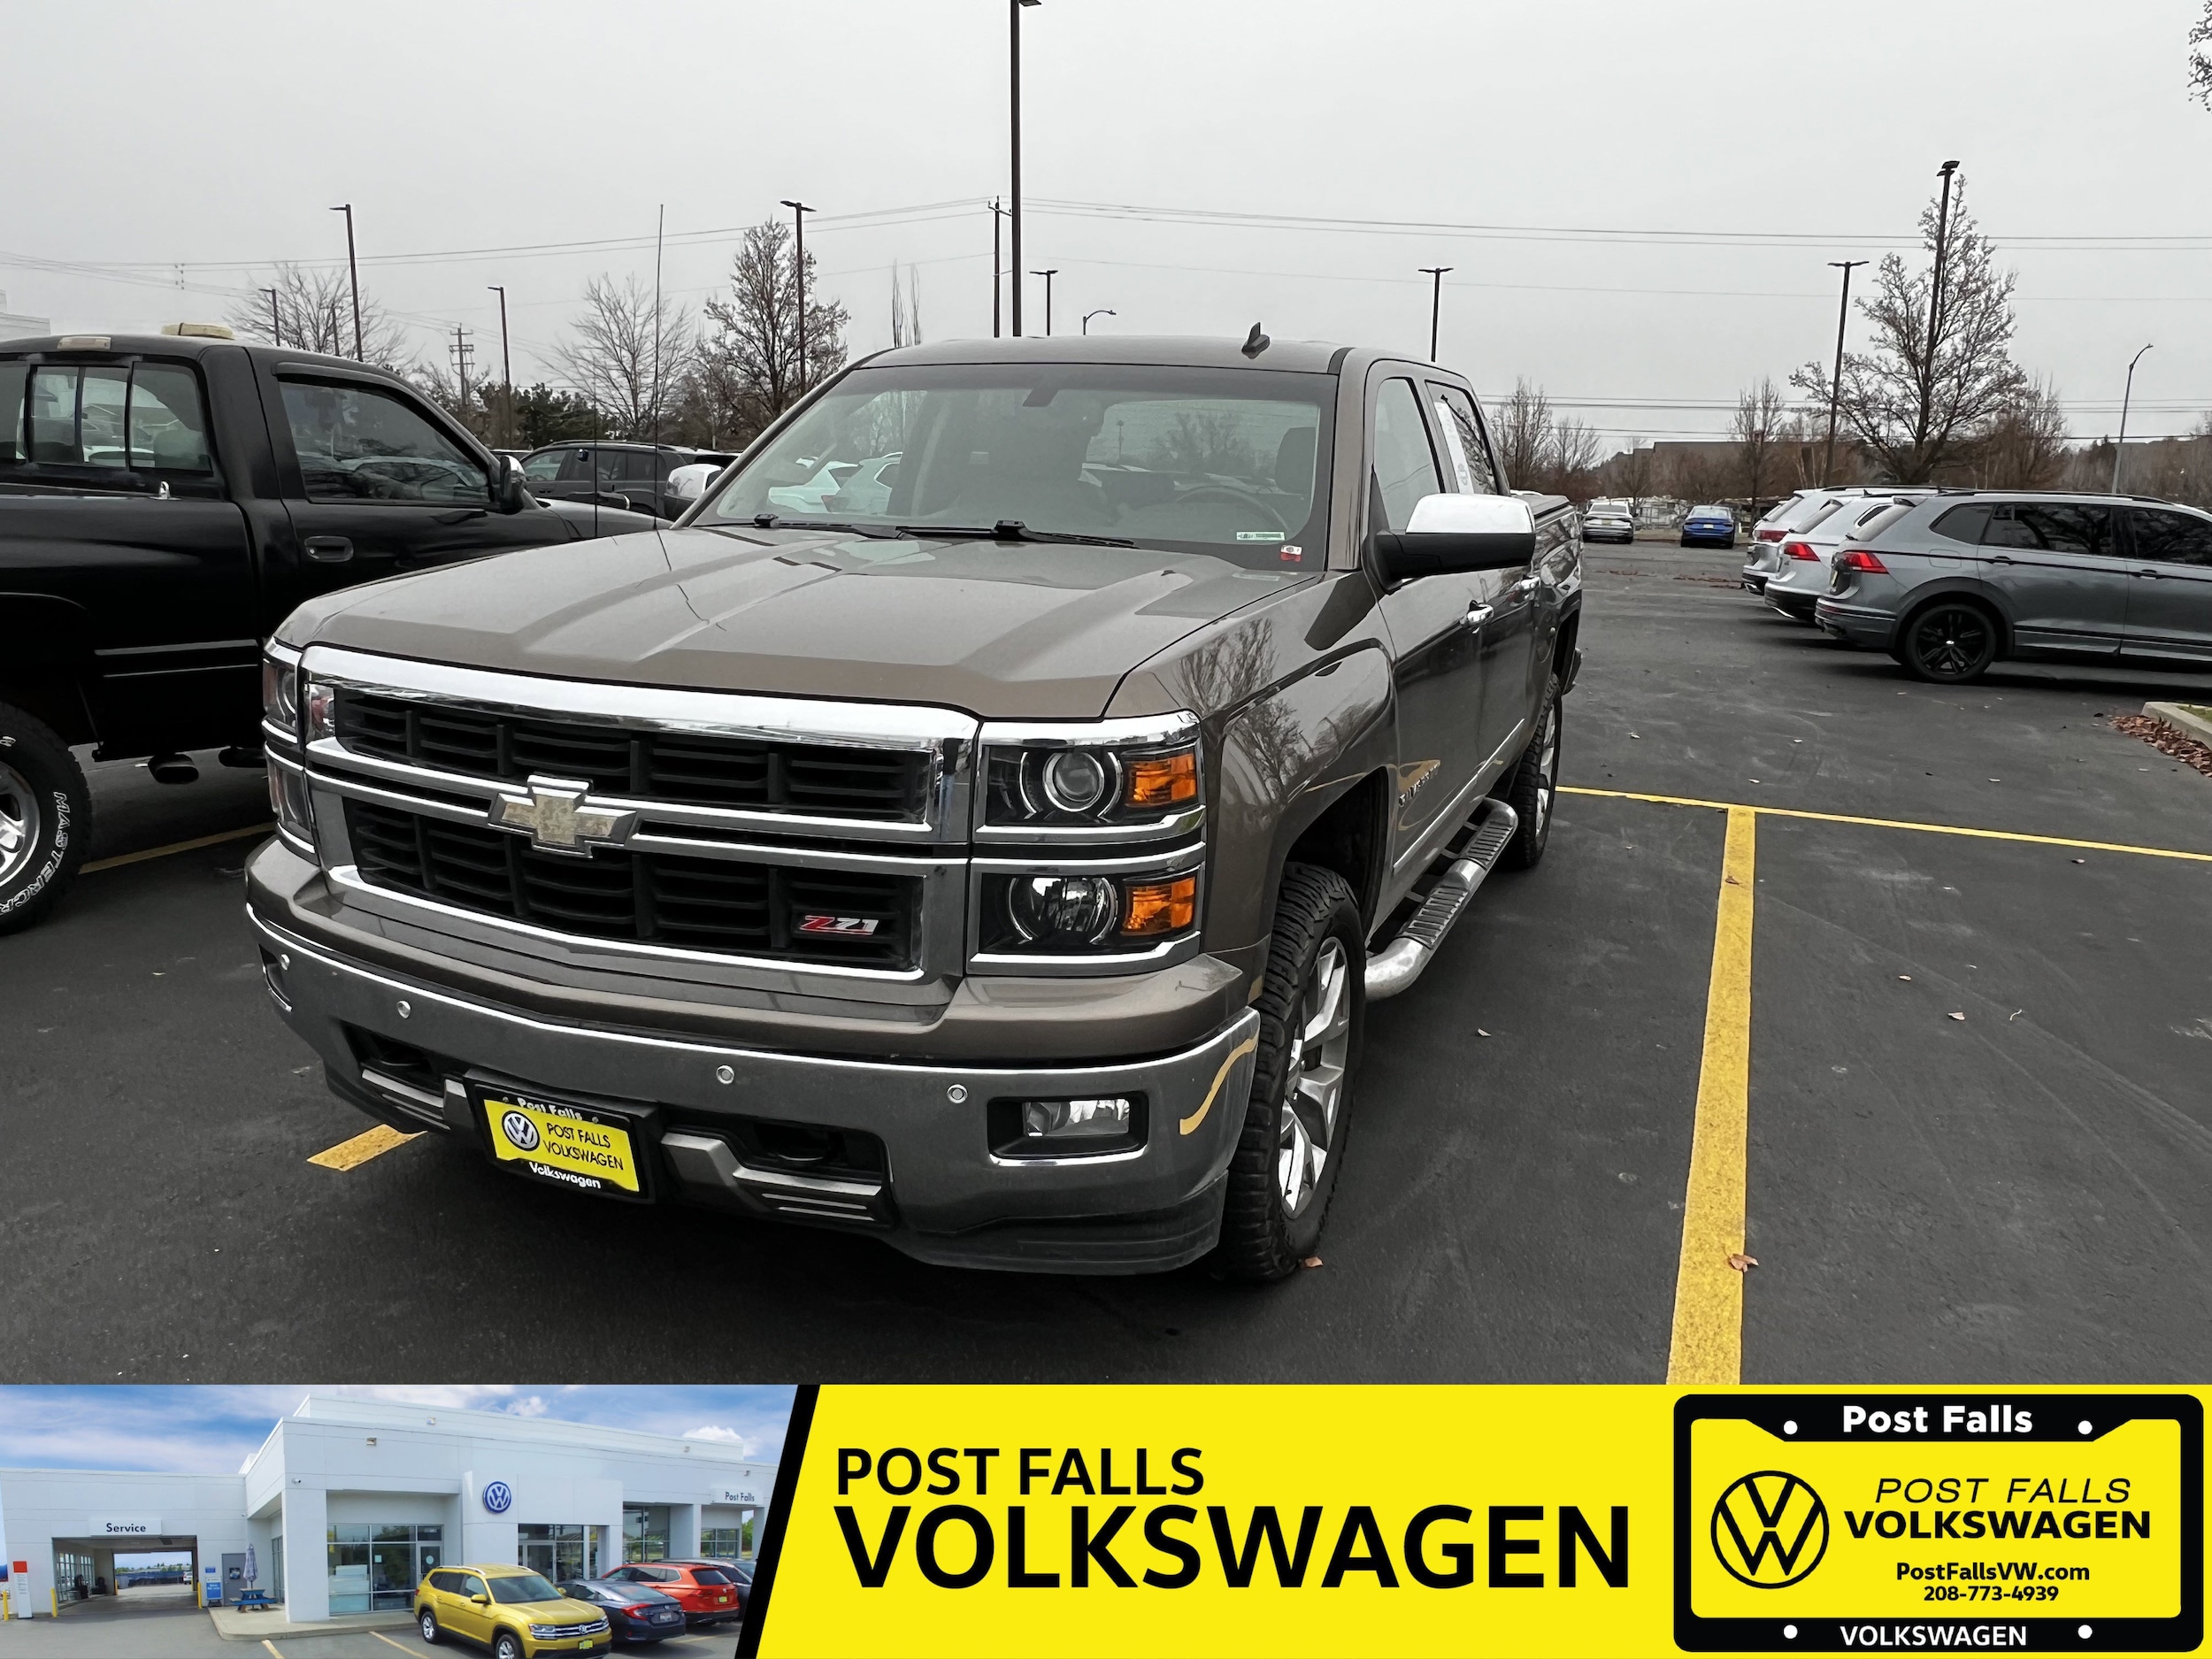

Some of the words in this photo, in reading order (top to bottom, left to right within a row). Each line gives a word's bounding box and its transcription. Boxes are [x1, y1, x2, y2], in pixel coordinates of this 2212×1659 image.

[0, 791, 70, 915] MASTERCR
[800, 915, 879, 935] Z71
[517, 1097, 546, 1113] Post
[549, 1104, 582, 1121] Falls
[547, 1122, 574, 1141] POST
[578, 1129, 611, 1148] FALLS
[542, 1140, 624, 1171] VOLKSWAGEN
[529, 1162, 601, 1189] Volkswagen
